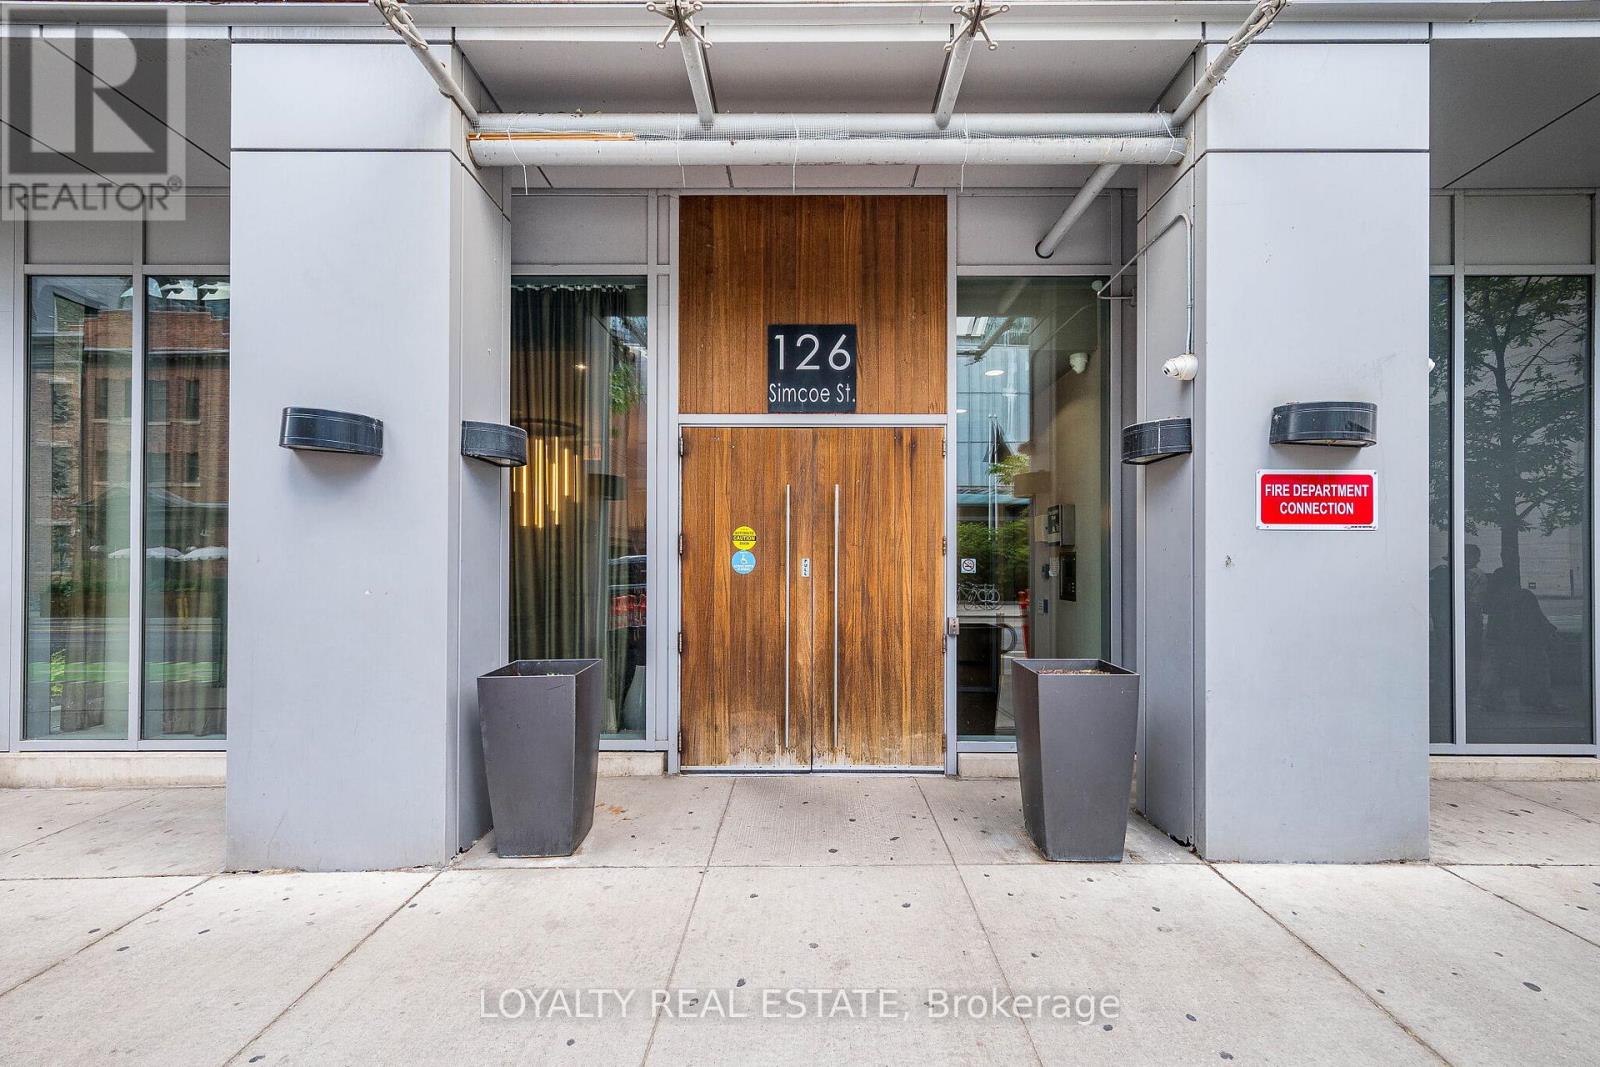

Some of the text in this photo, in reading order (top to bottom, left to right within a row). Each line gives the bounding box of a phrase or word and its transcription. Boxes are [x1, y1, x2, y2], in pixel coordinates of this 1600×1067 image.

[774, 333, 851, 371] 126
[768, 383, 856, 403] Simcoe St.
[1265, 484, 1369, 497] FIRE DEPARTMENT
[1280, 502, 1354, 515] CONNECTION
